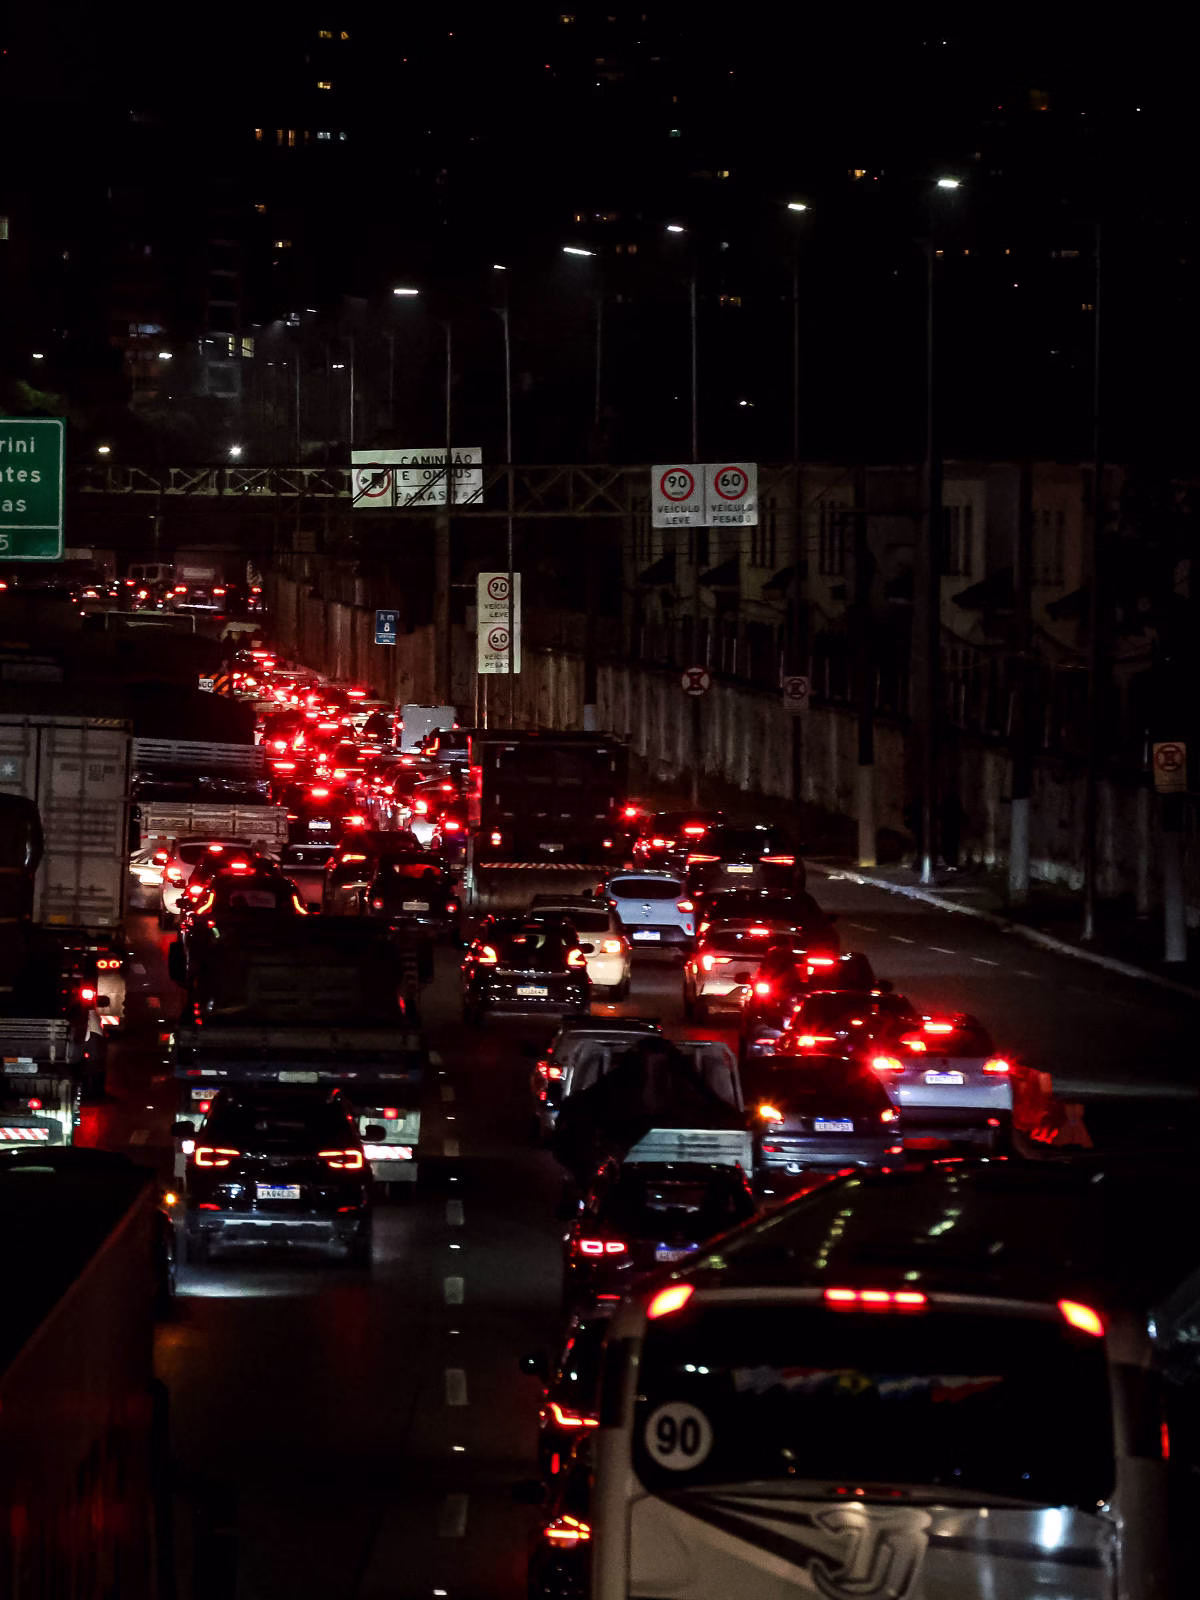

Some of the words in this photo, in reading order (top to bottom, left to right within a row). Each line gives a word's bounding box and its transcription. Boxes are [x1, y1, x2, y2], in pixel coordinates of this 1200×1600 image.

[402, 471, 410, 480] E
[721, 474, 741, 487] 60
[668, 475, 688, 488] 90
[666, 516, 691, 525] LEVE
[492, 582, 508, 593] 90
[383, 622, 390, 632] 8
[492, 633, 508, 643] 60
[657, 1415, 702, 1456] 90
